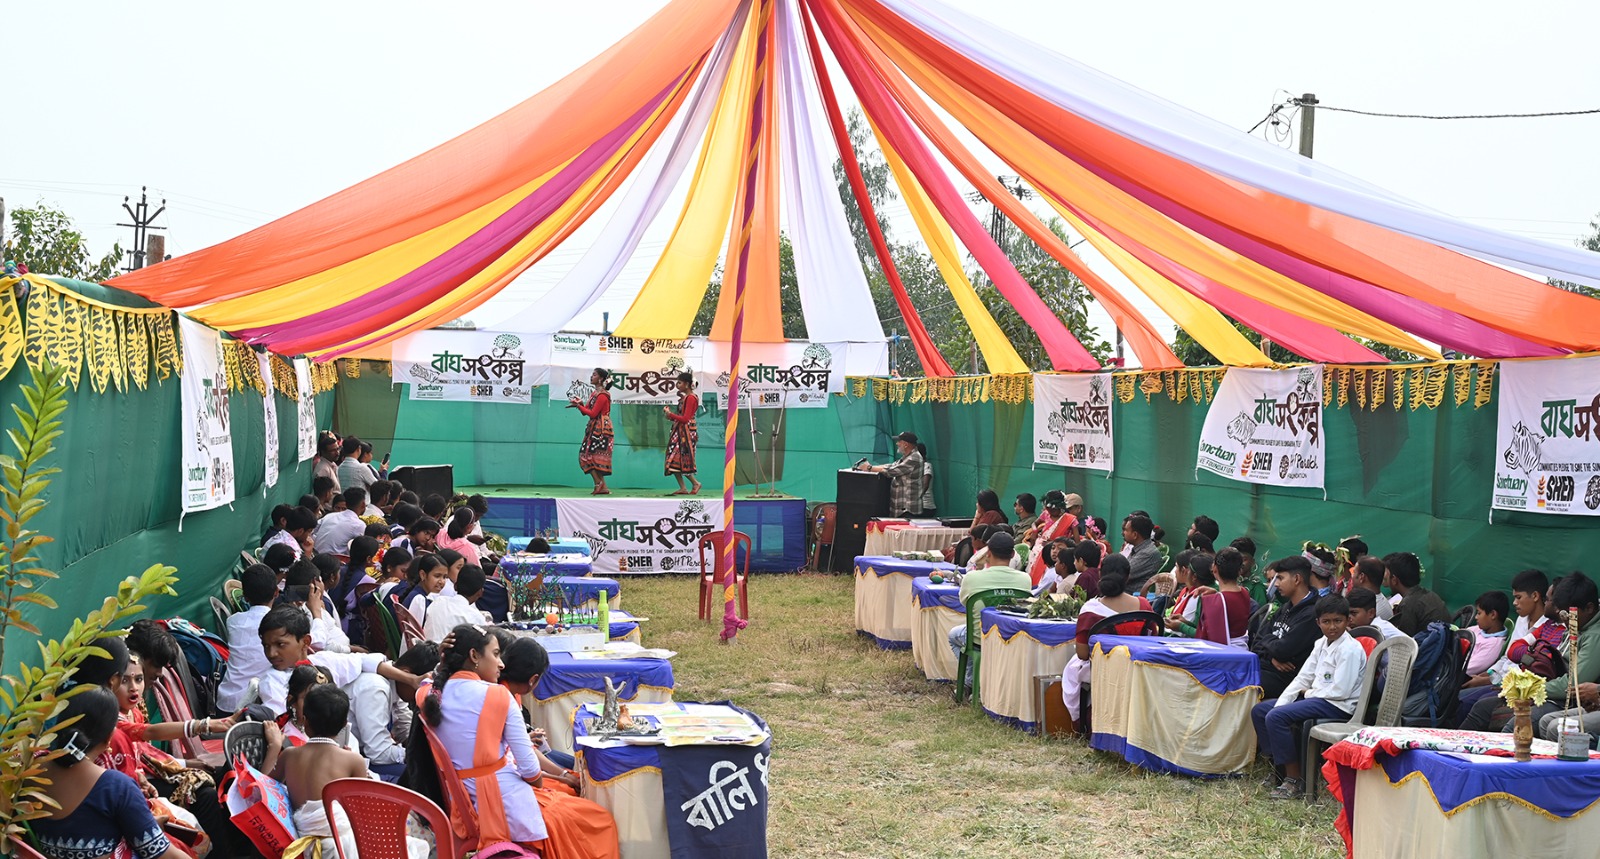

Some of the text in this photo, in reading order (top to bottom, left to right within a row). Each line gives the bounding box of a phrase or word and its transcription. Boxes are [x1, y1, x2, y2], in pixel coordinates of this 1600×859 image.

[553, 334, 586, 347] Sanctuary
[607, 336, 633, 349] SHER
[476, 384, 493, 397] SHER
[764, 392, 780, 404] SHER
[1073, 443, 1086, 460] SHER
[1200, 439, 1238, 466] anctuary
[1251, 451, 1273, 471] SHER
[1546, 475, 1575, 502] SHER
[628, 555, 653, 568] SHER
[686, 555, 711, 567] Pareh
[680, 760, 758, 831] বালি
